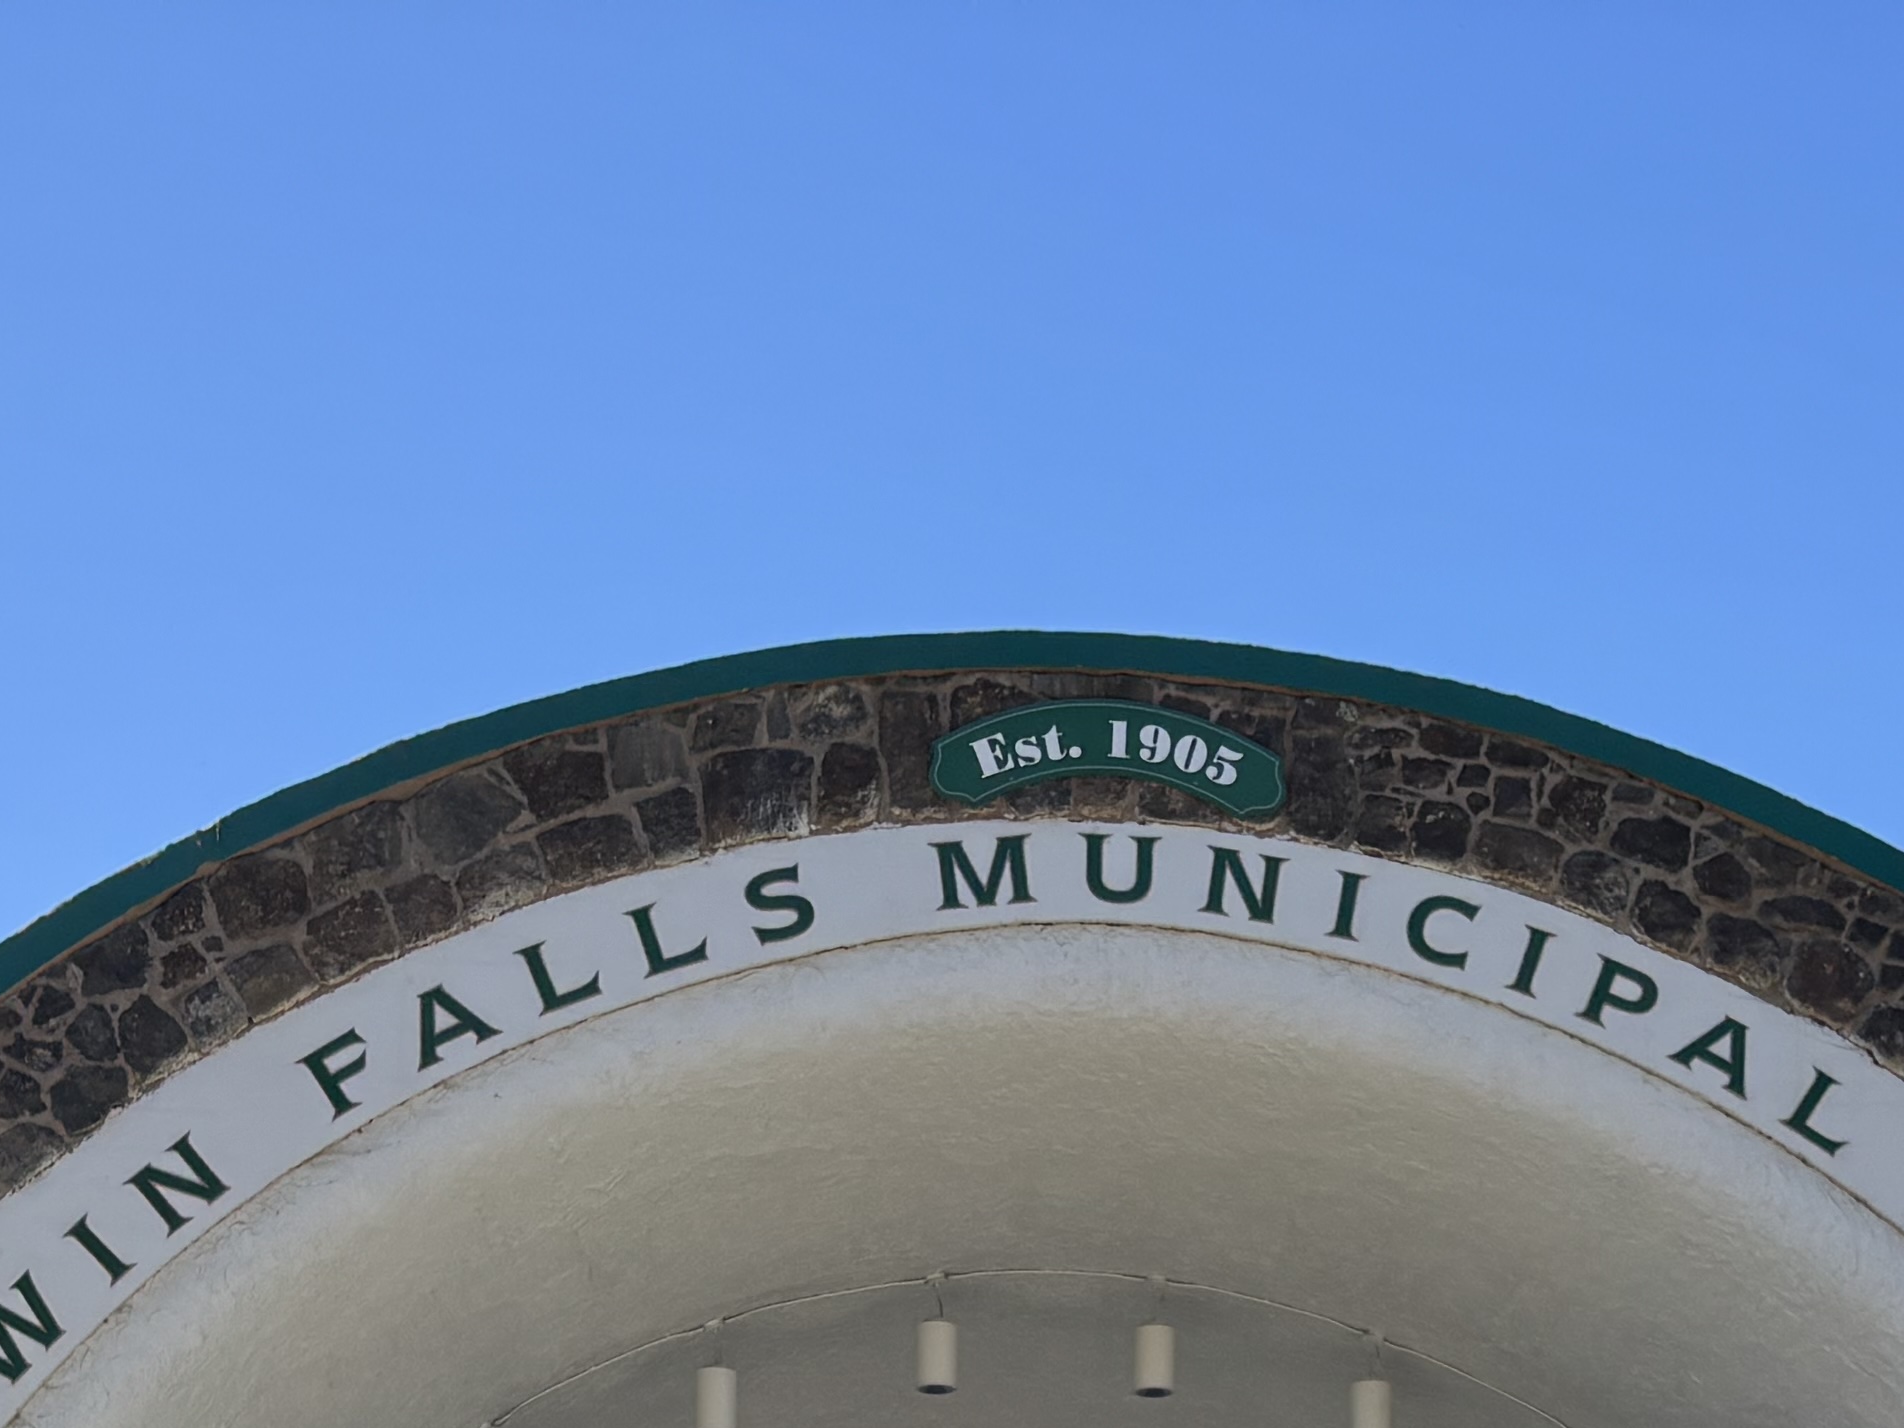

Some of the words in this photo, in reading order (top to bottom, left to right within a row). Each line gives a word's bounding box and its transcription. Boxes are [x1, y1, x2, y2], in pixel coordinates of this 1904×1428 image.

[969, 724, 1082, 779] Est.
[1108, 720, 1244, 785] 1905
[295, 862, 815, 1122] FALLS
[927, 832, 1850, 1157] MUNICIPAL
